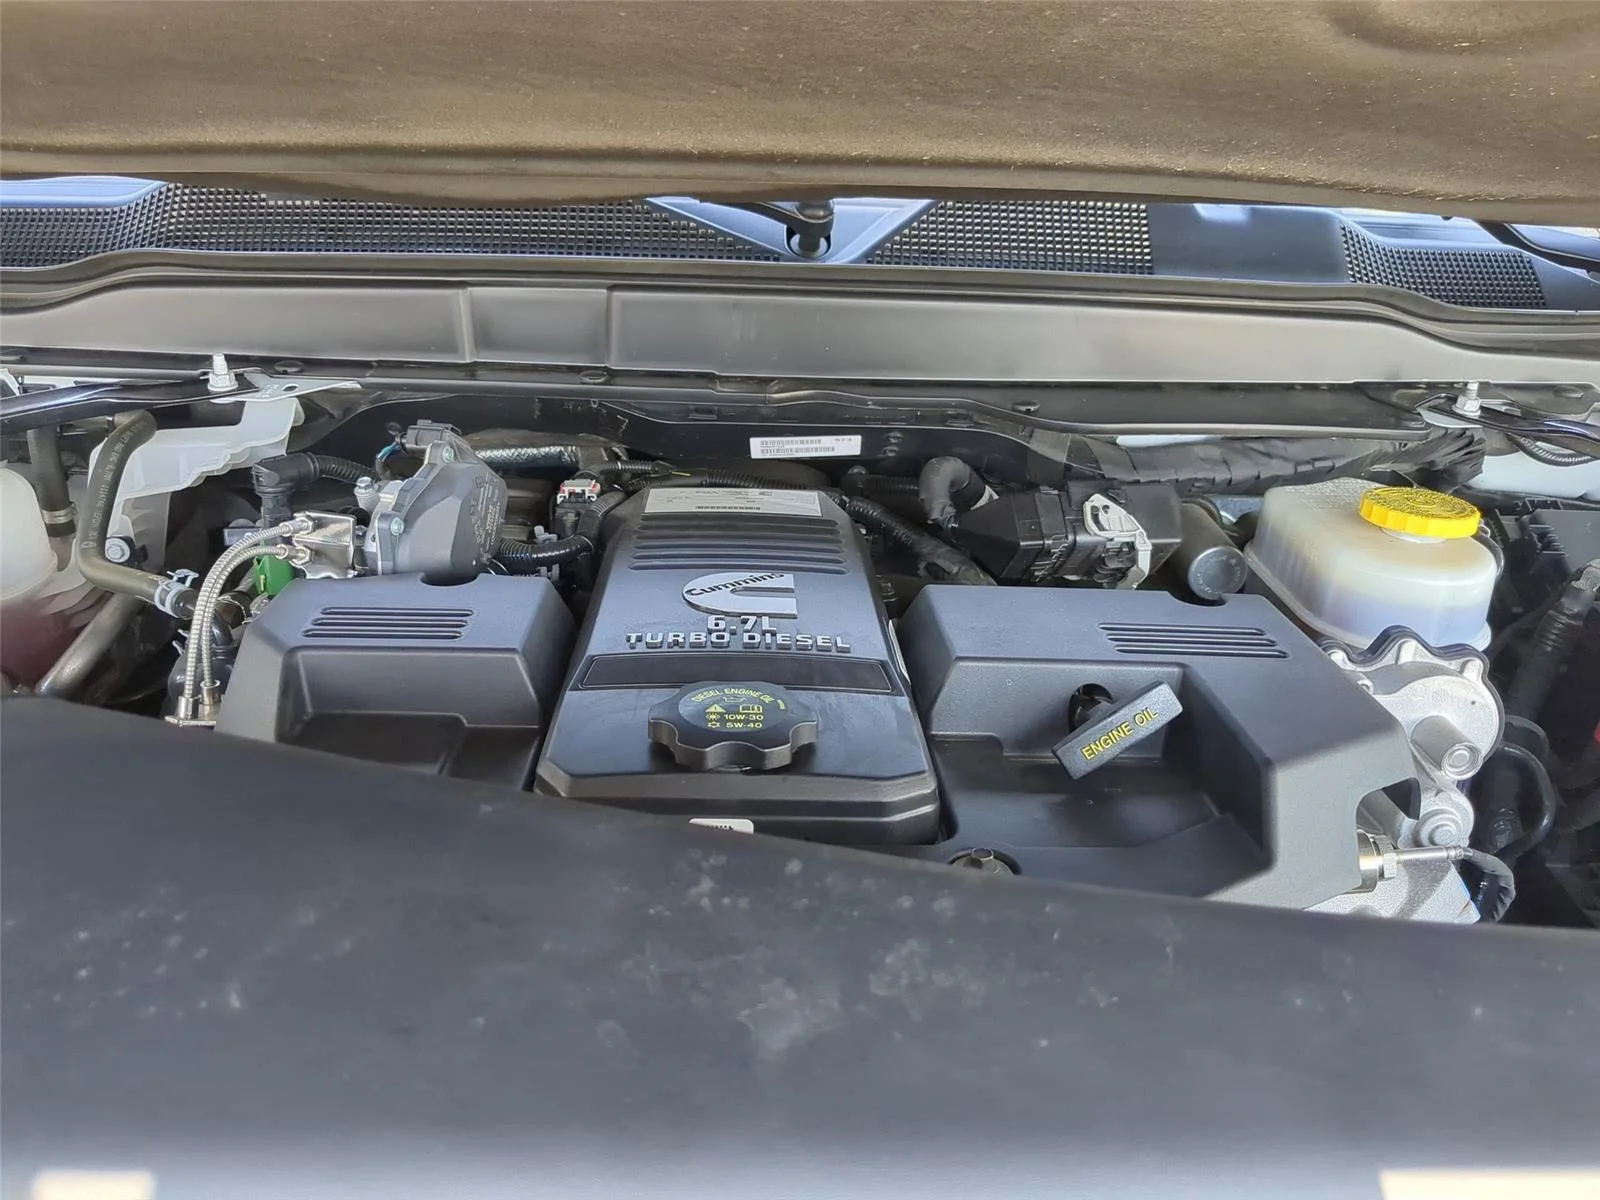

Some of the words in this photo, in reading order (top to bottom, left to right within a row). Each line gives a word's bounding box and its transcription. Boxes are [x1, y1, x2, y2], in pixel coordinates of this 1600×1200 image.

[685, 572, 785, 596] Cummins
[707, 615, 777, 635] 6.7L
[626, 632, 731, 649] TURBO
[742, 632, 852, 653] DIESEL
[691, 690, 723, 702] DIESEL
[724, 688, 762, 697] ENGINE
[760, 694, 775, 704] OIL
[1081, 721, 1134, 760] ENGINE
[1134, 707, 1159, 728] OIL
